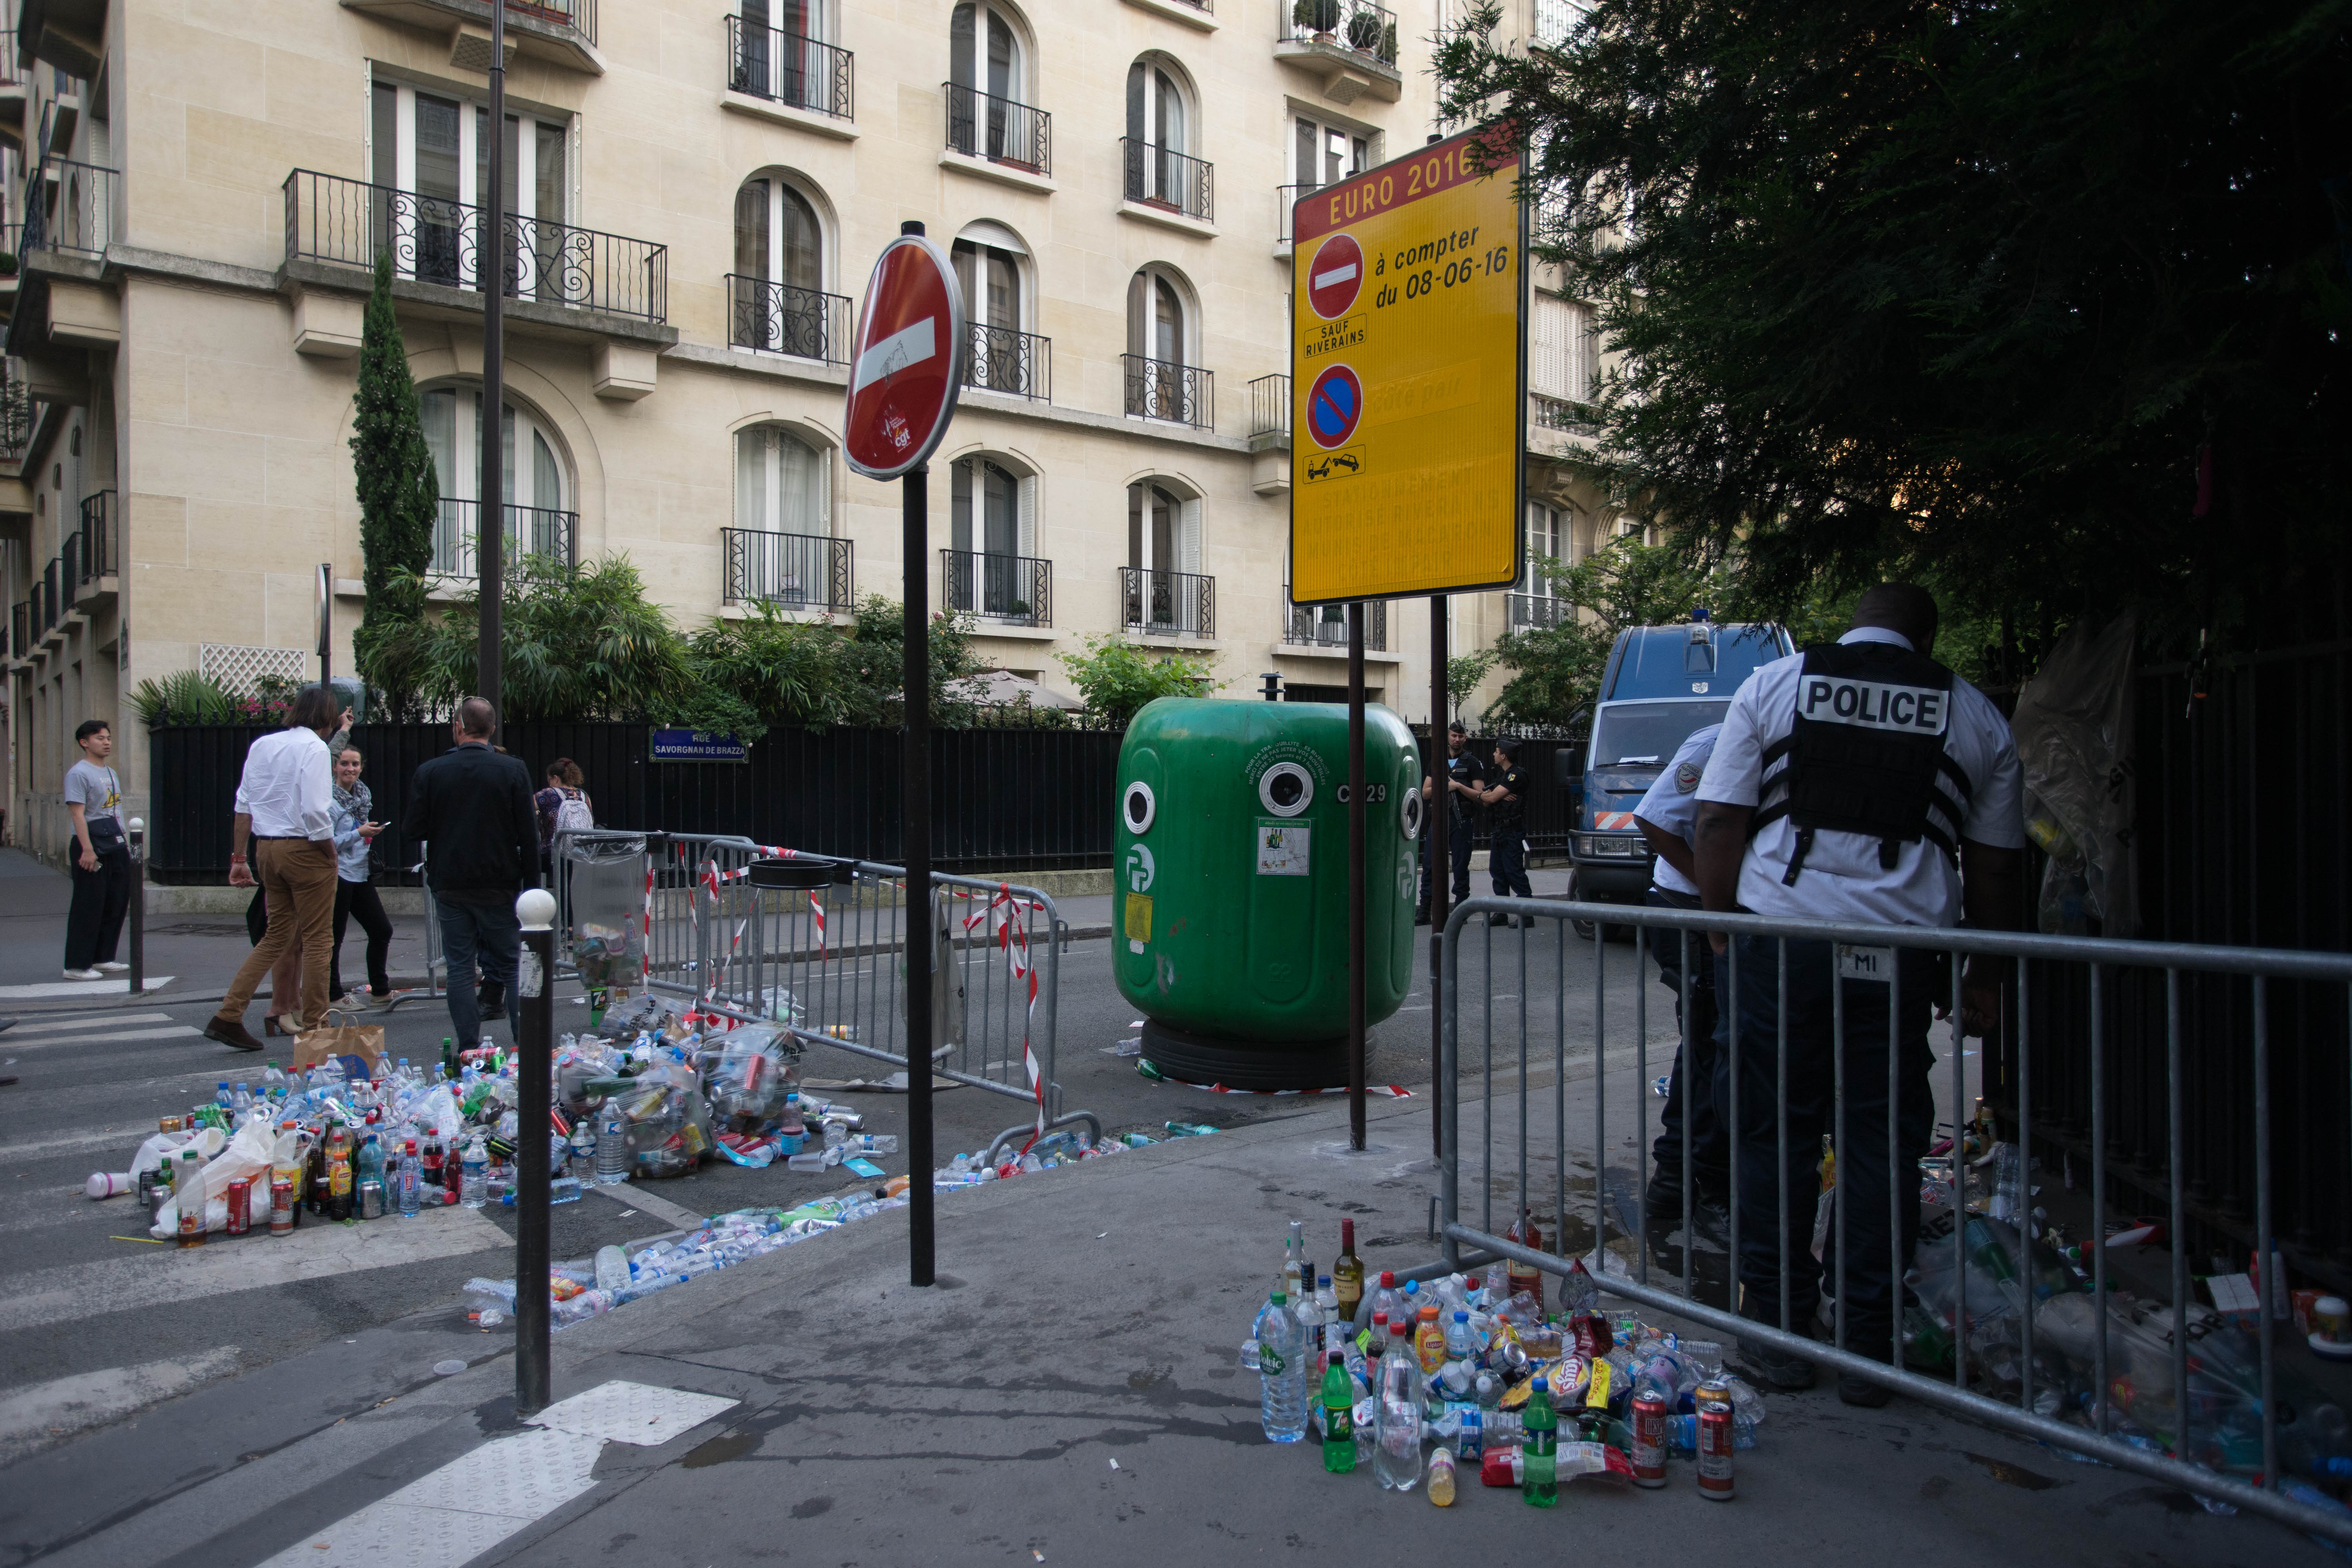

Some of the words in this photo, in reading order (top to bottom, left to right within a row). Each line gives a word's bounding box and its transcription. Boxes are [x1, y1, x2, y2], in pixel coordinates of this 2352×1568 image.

[1330, 176, 1393, 226] EURO
[1408, 143, 1473, 197] 2016
[1376, 252, 1384, 277] à
[1395, 226, 1479, 270] compter
[1376, 284, 1397, 309] du
[1406, 246, 1508, 300] 08-06-16
[1321, 320, 1349, 339] SAUF
[1306, 330, 1364, 356] RIVERAINS
[895, 428, 910, 446] cgt
[1806, 681, 1939, 729] POLICE
[693, 734, 711, 742] RUE
[655, 746, 704, 754] SAVORGNAN
[1245, 758, 1255, 774] POUR
[1256, 762, 1268, 778] ENTRE
[1305, 761, 1318, 779] heures
[1298, 749, 1309, 757] VOS
[1309, 756, 1326, 786] BOUTEILLES
[1687, 765, 1700, 774] POLICE
[1855, 954, 1876, 972] MI
